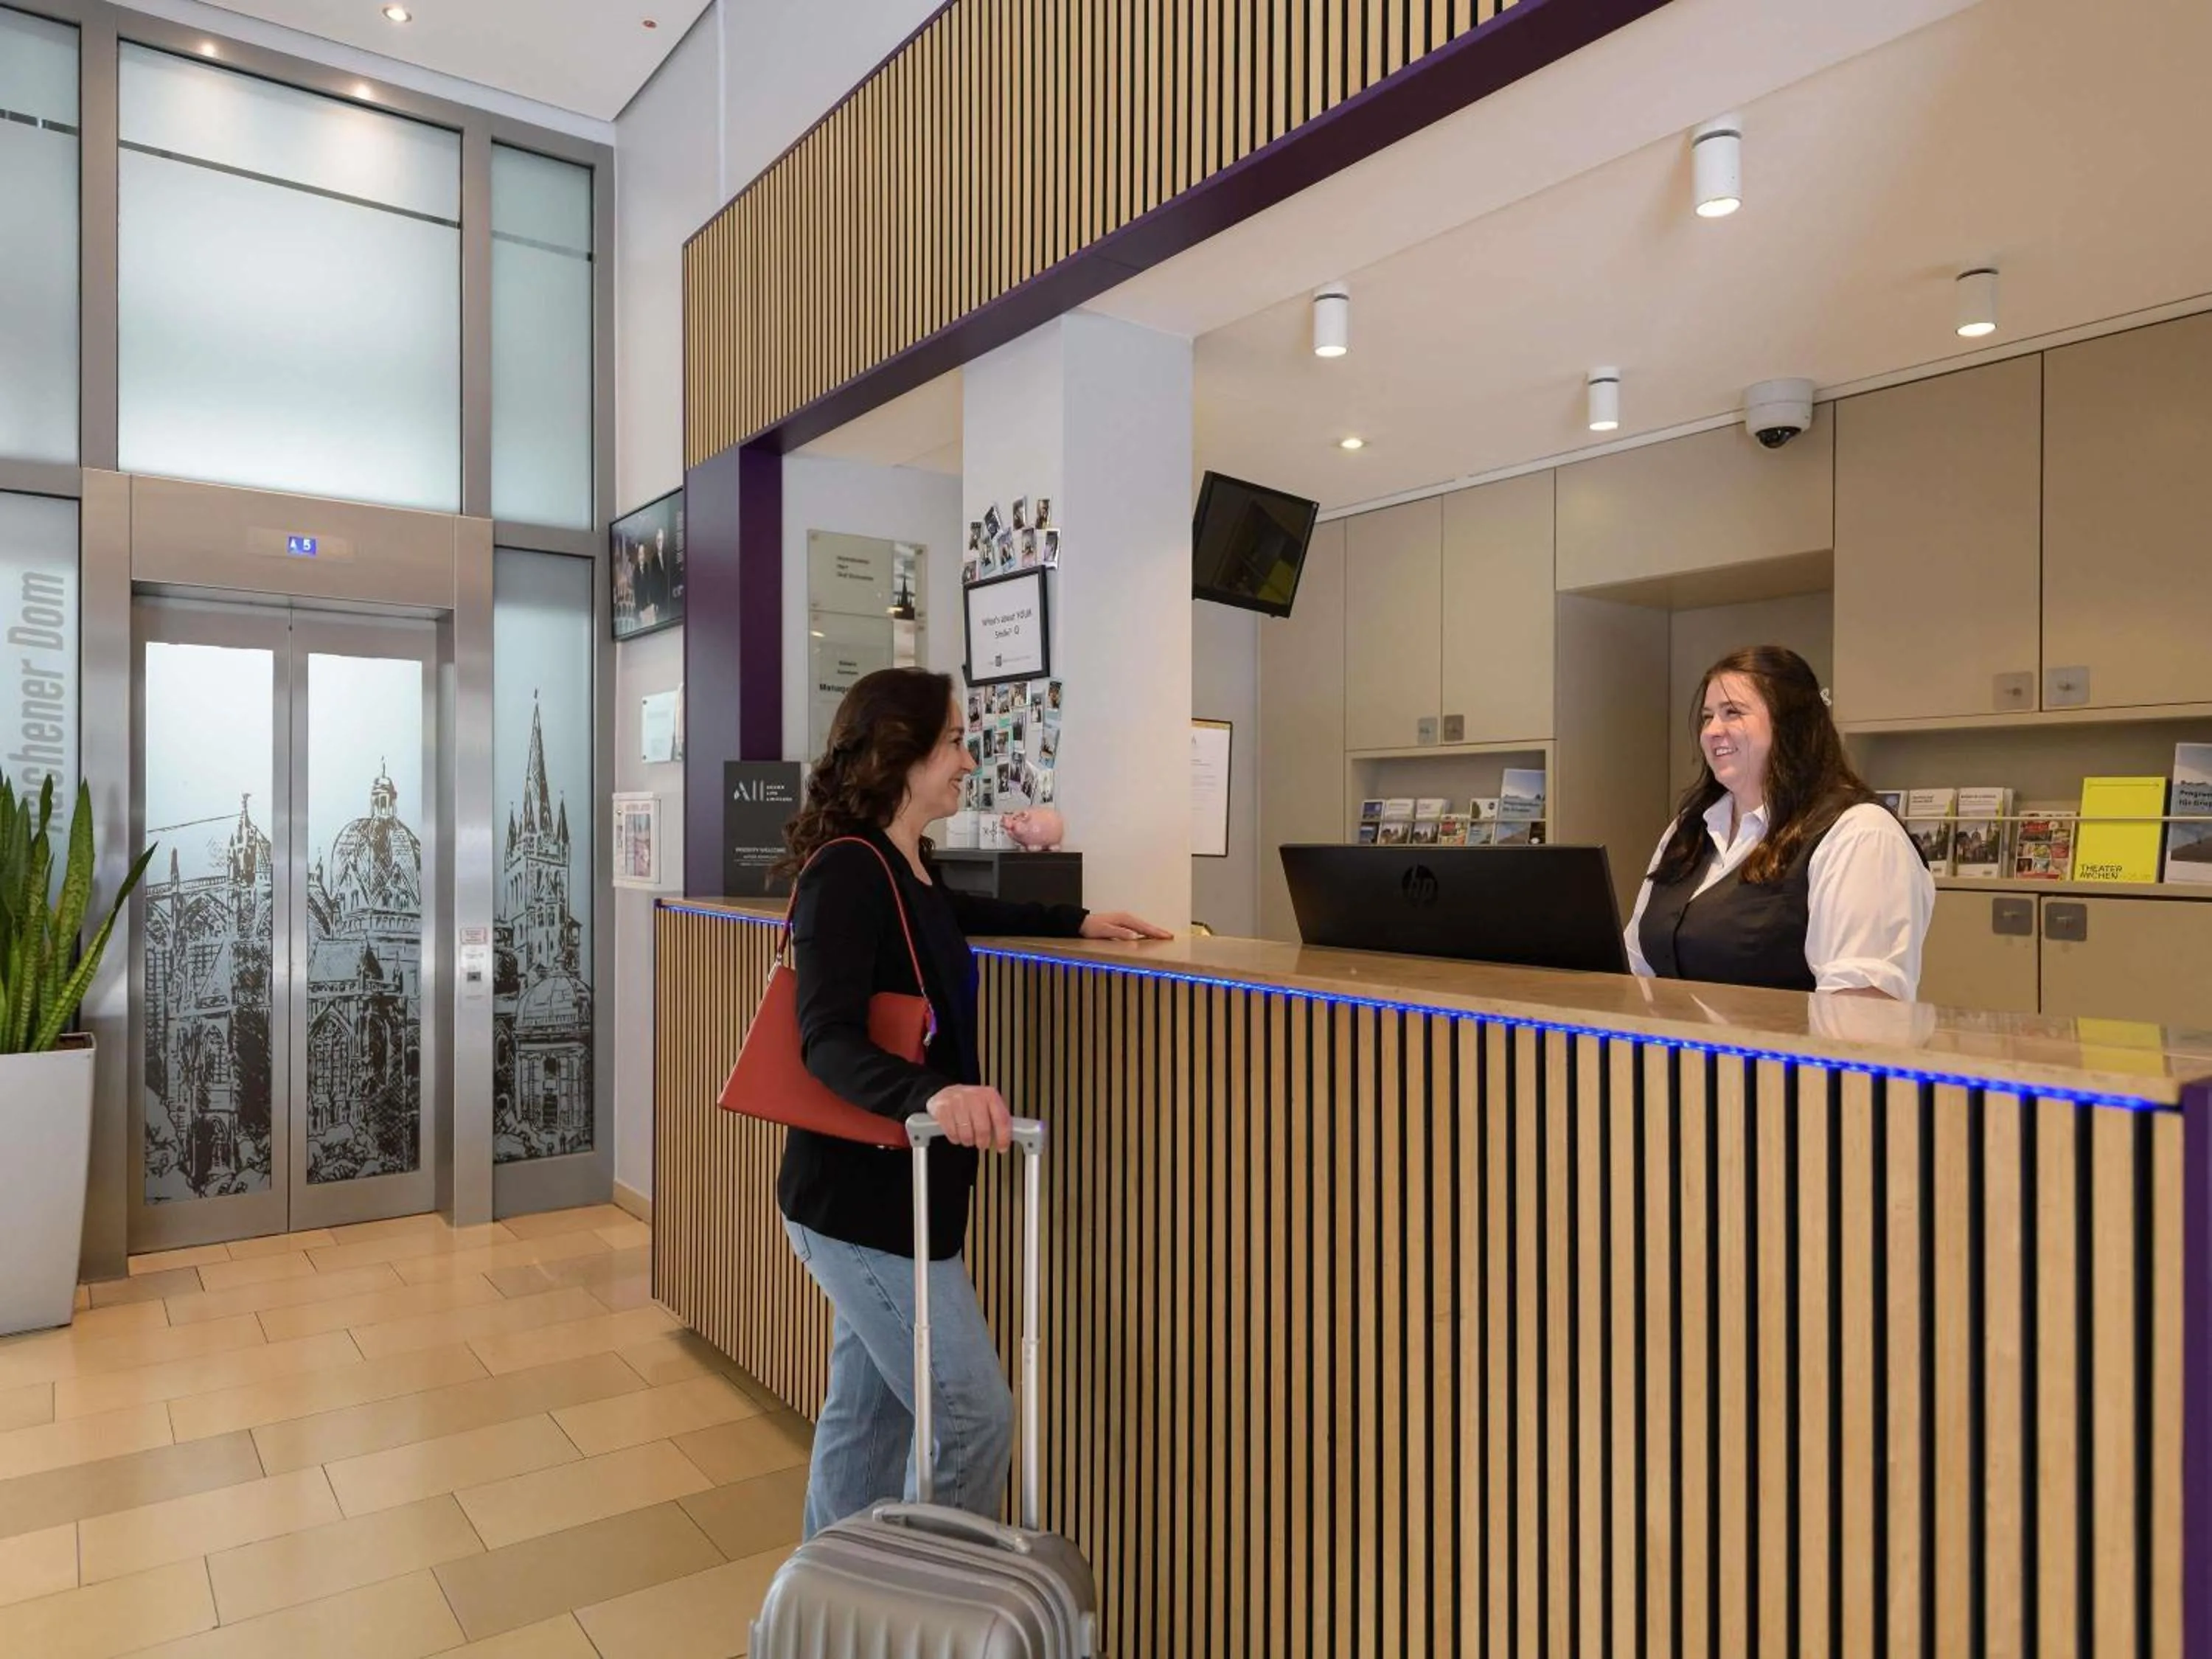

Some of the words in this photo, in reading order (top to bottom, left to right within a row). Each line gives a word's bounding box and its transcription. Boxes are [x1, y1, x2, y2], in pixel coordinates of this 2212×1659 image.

[303, 539, 311, 551] 5
[7, 571, 64, 650] Dom
[2079, 864, 2123, 872] THEATER
